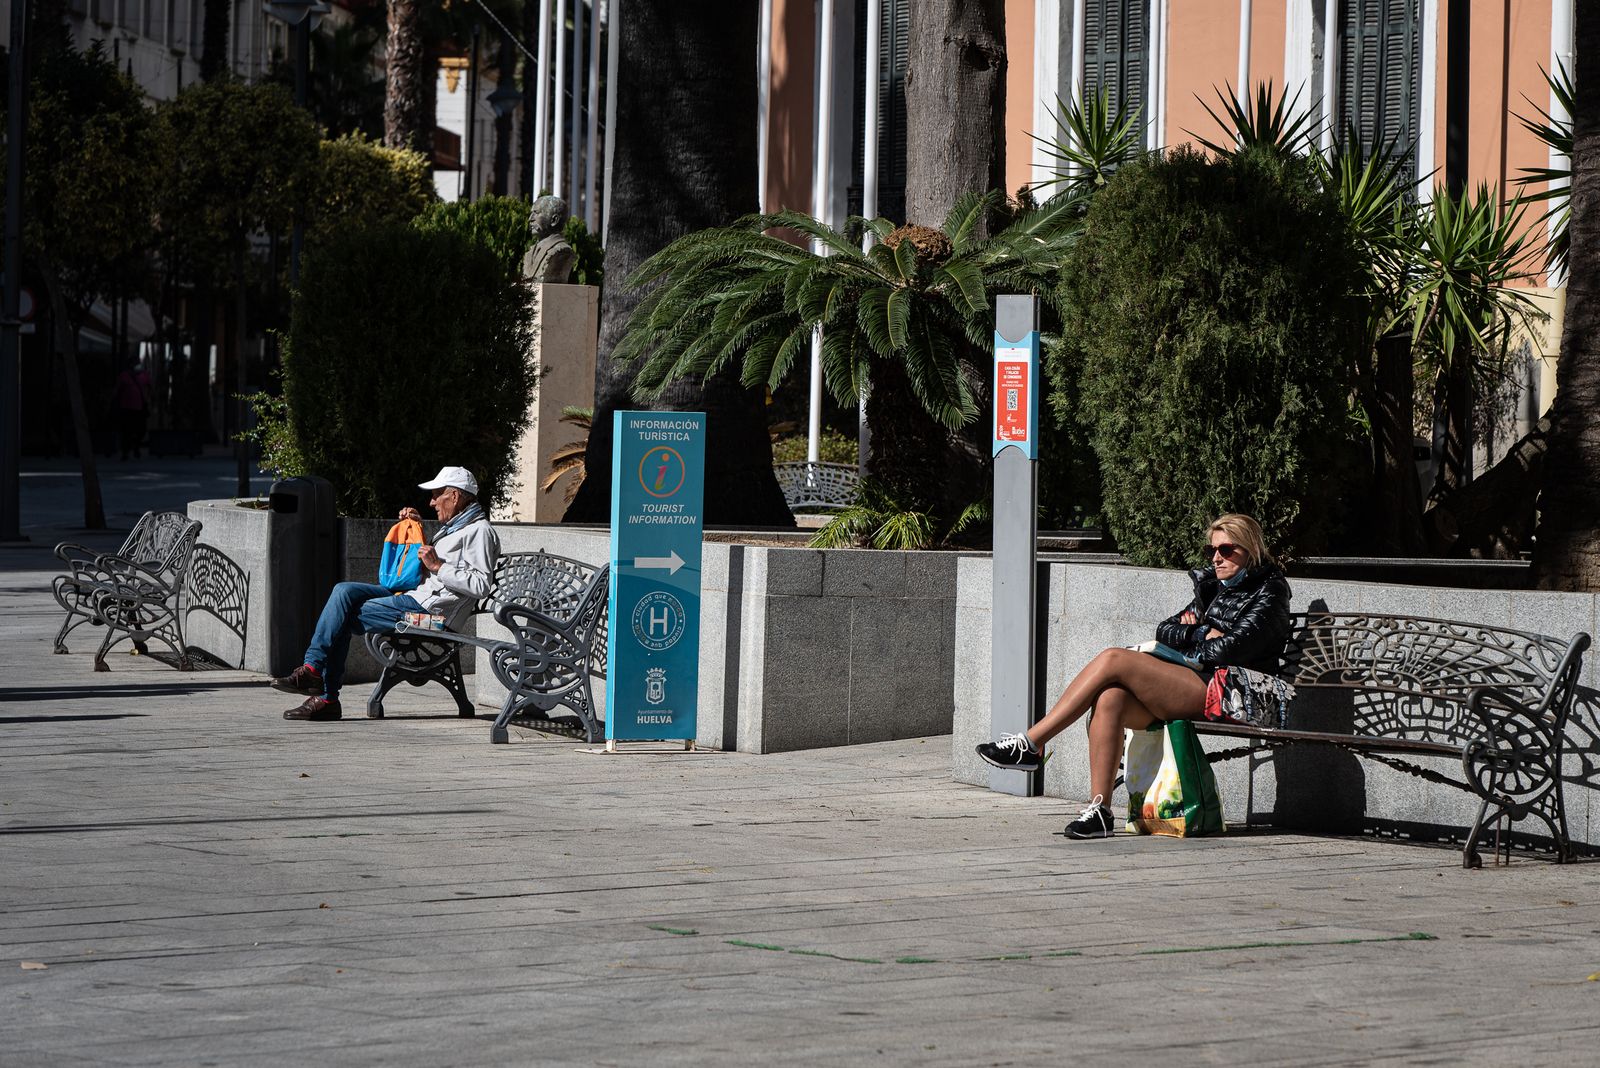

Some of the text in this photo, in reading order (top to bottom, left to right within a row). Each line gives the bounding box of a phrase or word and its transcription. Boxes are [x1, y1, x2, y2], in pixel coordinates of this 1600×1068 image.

[630, 419, 699, 430] INFORMACIÓN
[639, 430, 690, 441] TURÍSTICA
[642, 504, 684, 513] TOURIST
[628, 515, 696, 525] INFORMATION
[635, 596, 653, 617] ciudad
[650, 606, 668, 635] H
[637, 715, 673, 724] HUELVA
